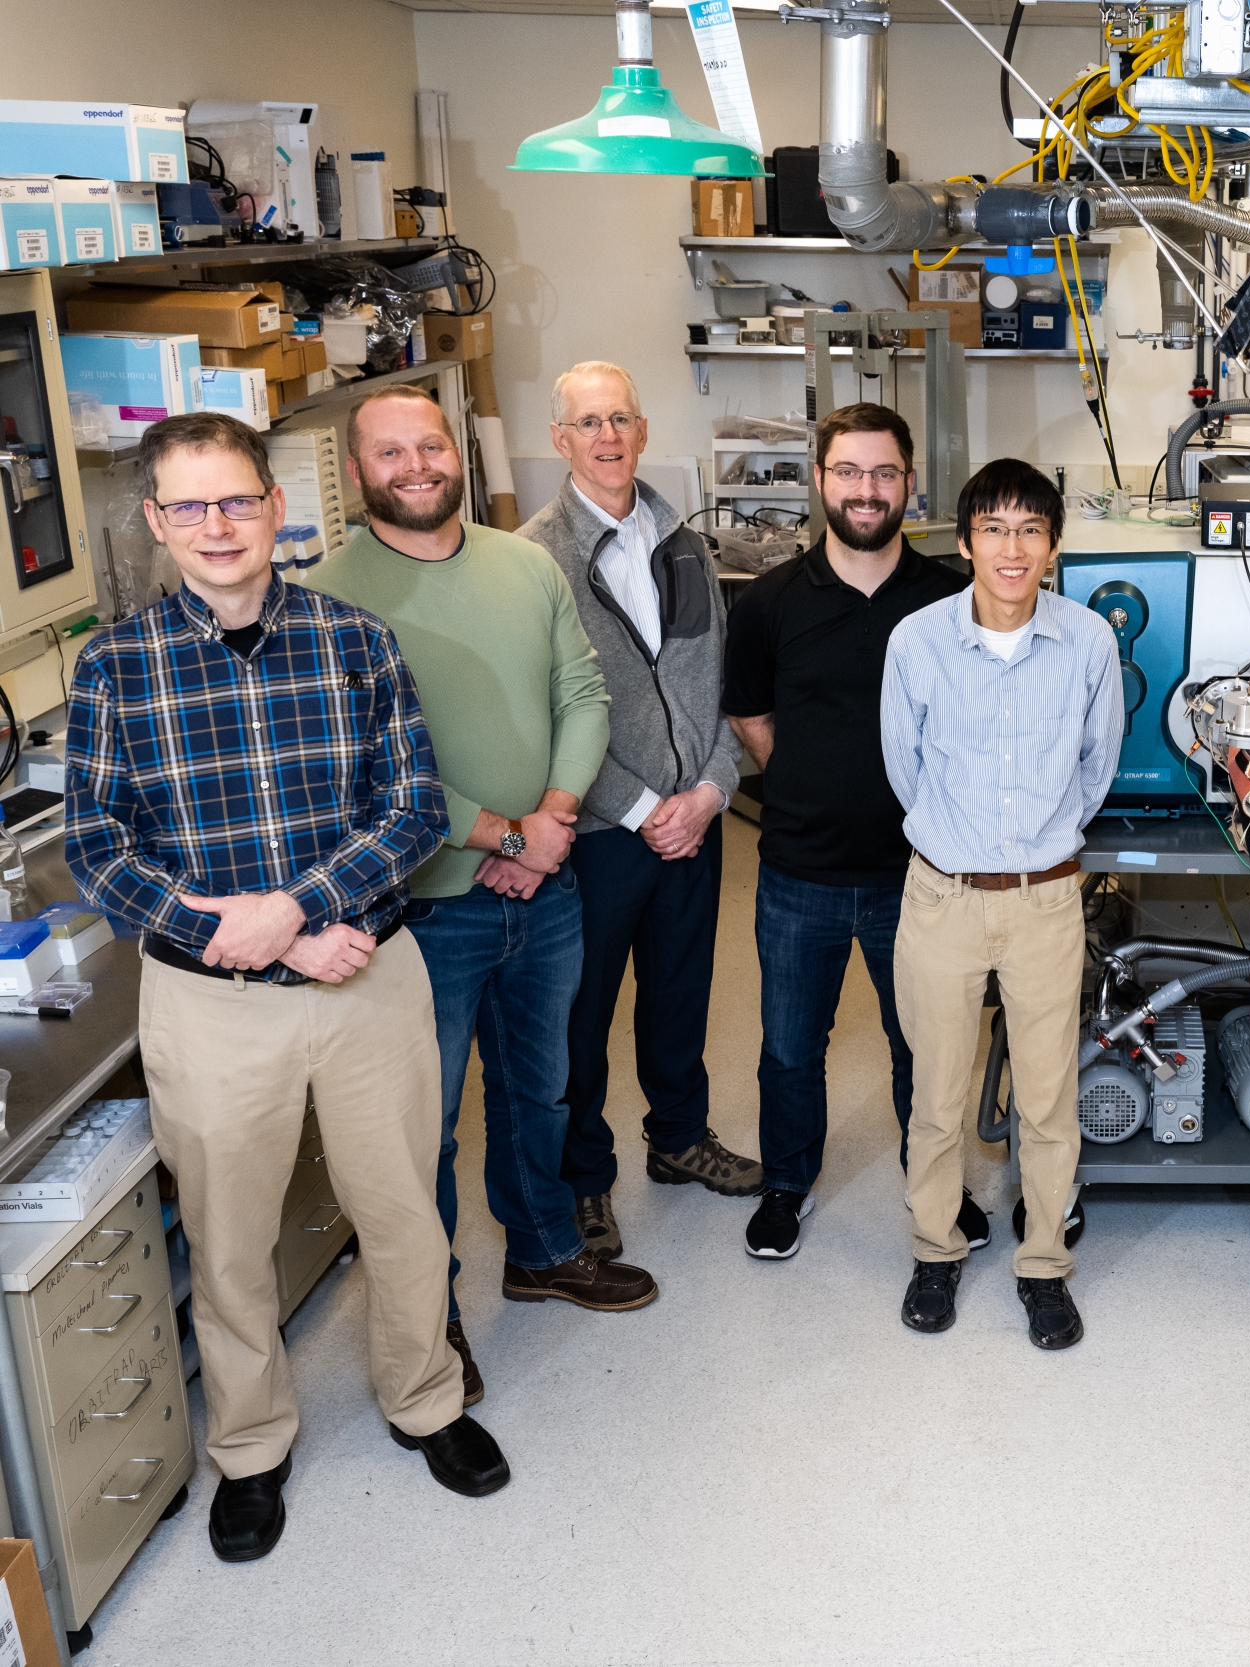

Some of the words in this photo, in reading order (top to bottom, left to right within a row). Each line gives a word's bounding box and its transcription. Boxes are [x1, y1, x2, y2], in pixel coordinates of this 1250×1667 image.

[701, 1, 723, 14] SAFETY
[696, 12, 730, 27] INSPECTION
[83, 110, 123, 118] eppendorf
[27, 185, 49, 196] eppendorf
[89, 186, 109, 196] eppendorf
[301, 326, 318, 334] wrap
[170, 343, 179, 382] eppendorf
[79, 370, 93, 379] life
[95, 370, 117, 379] with
[119, 371, 143, 380] touch
[147, 373, 157, 382] In
[21, 1202, 43, 1210] Vials
